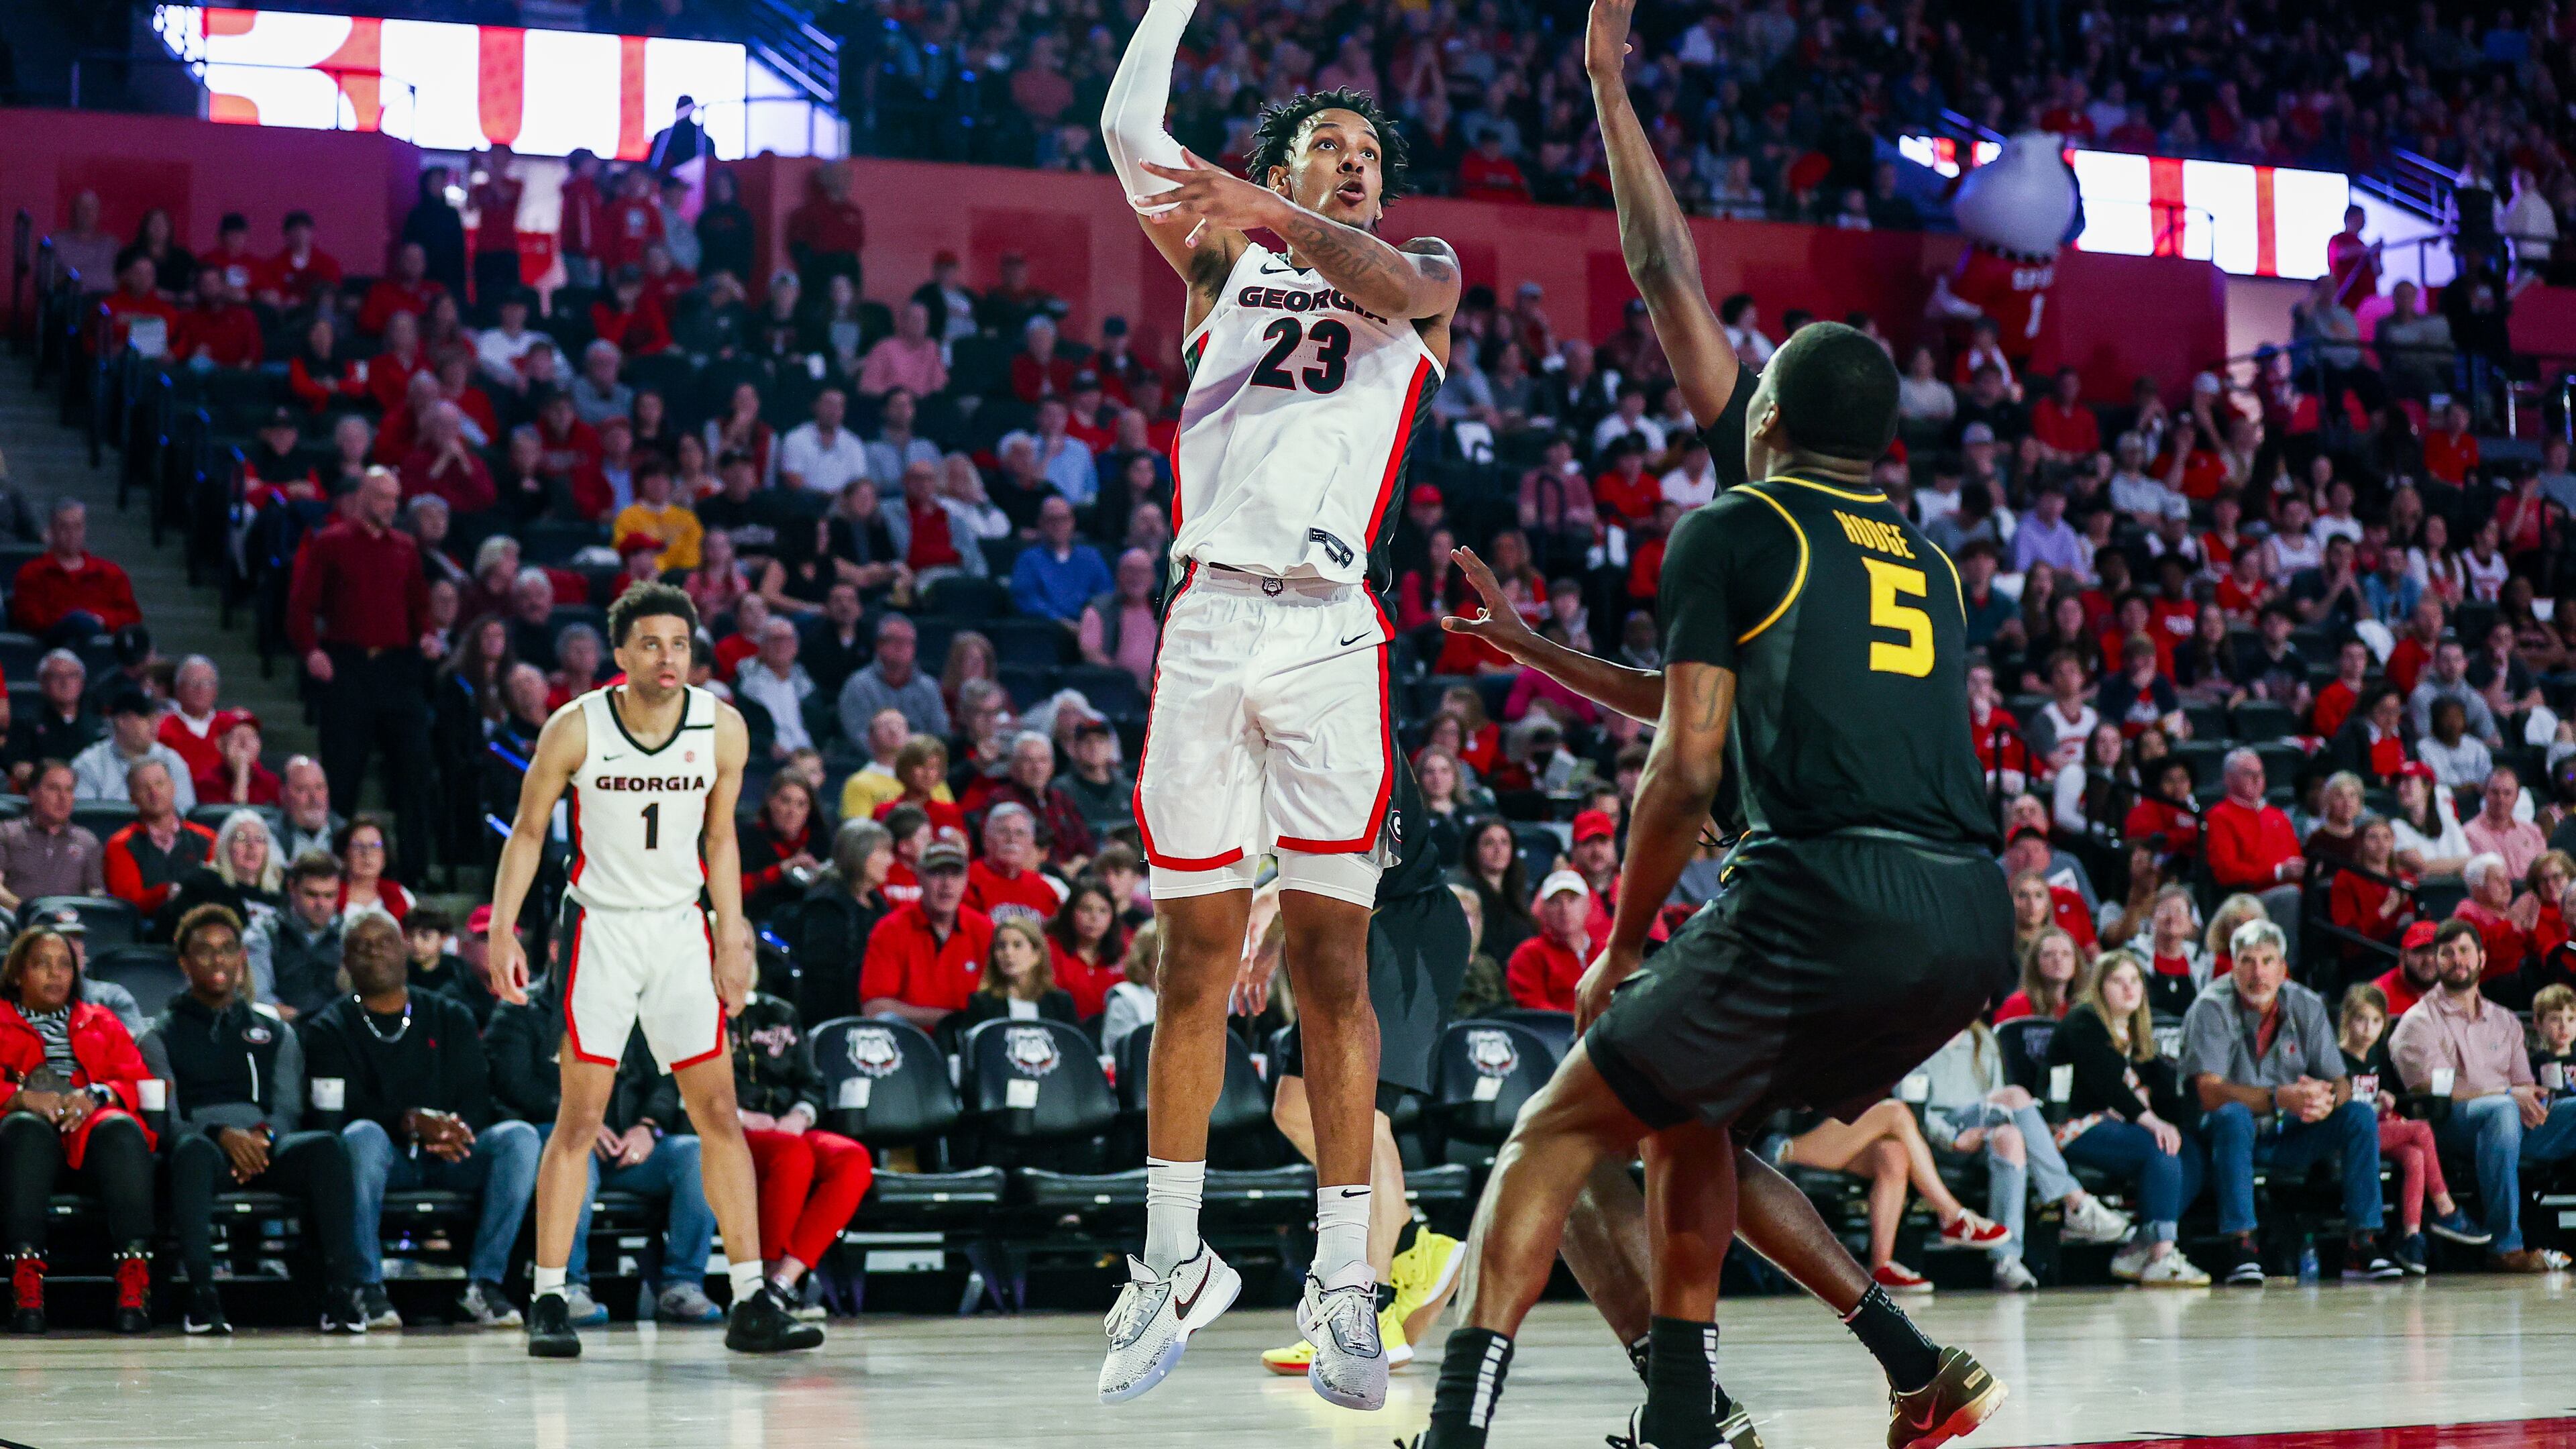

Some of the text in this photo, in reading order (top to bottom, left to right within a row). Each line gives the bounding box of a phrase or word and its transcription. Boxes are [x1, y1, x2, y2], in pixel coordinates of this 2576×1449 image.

[1249, 317, 1352, 394] 23
[1832, 508, 1917, 560] HODGE
[1861, 555, 1937, 679] 5
[596, 775, 704, 792] GEORGIA
[641, 802, 659, 850] 1
